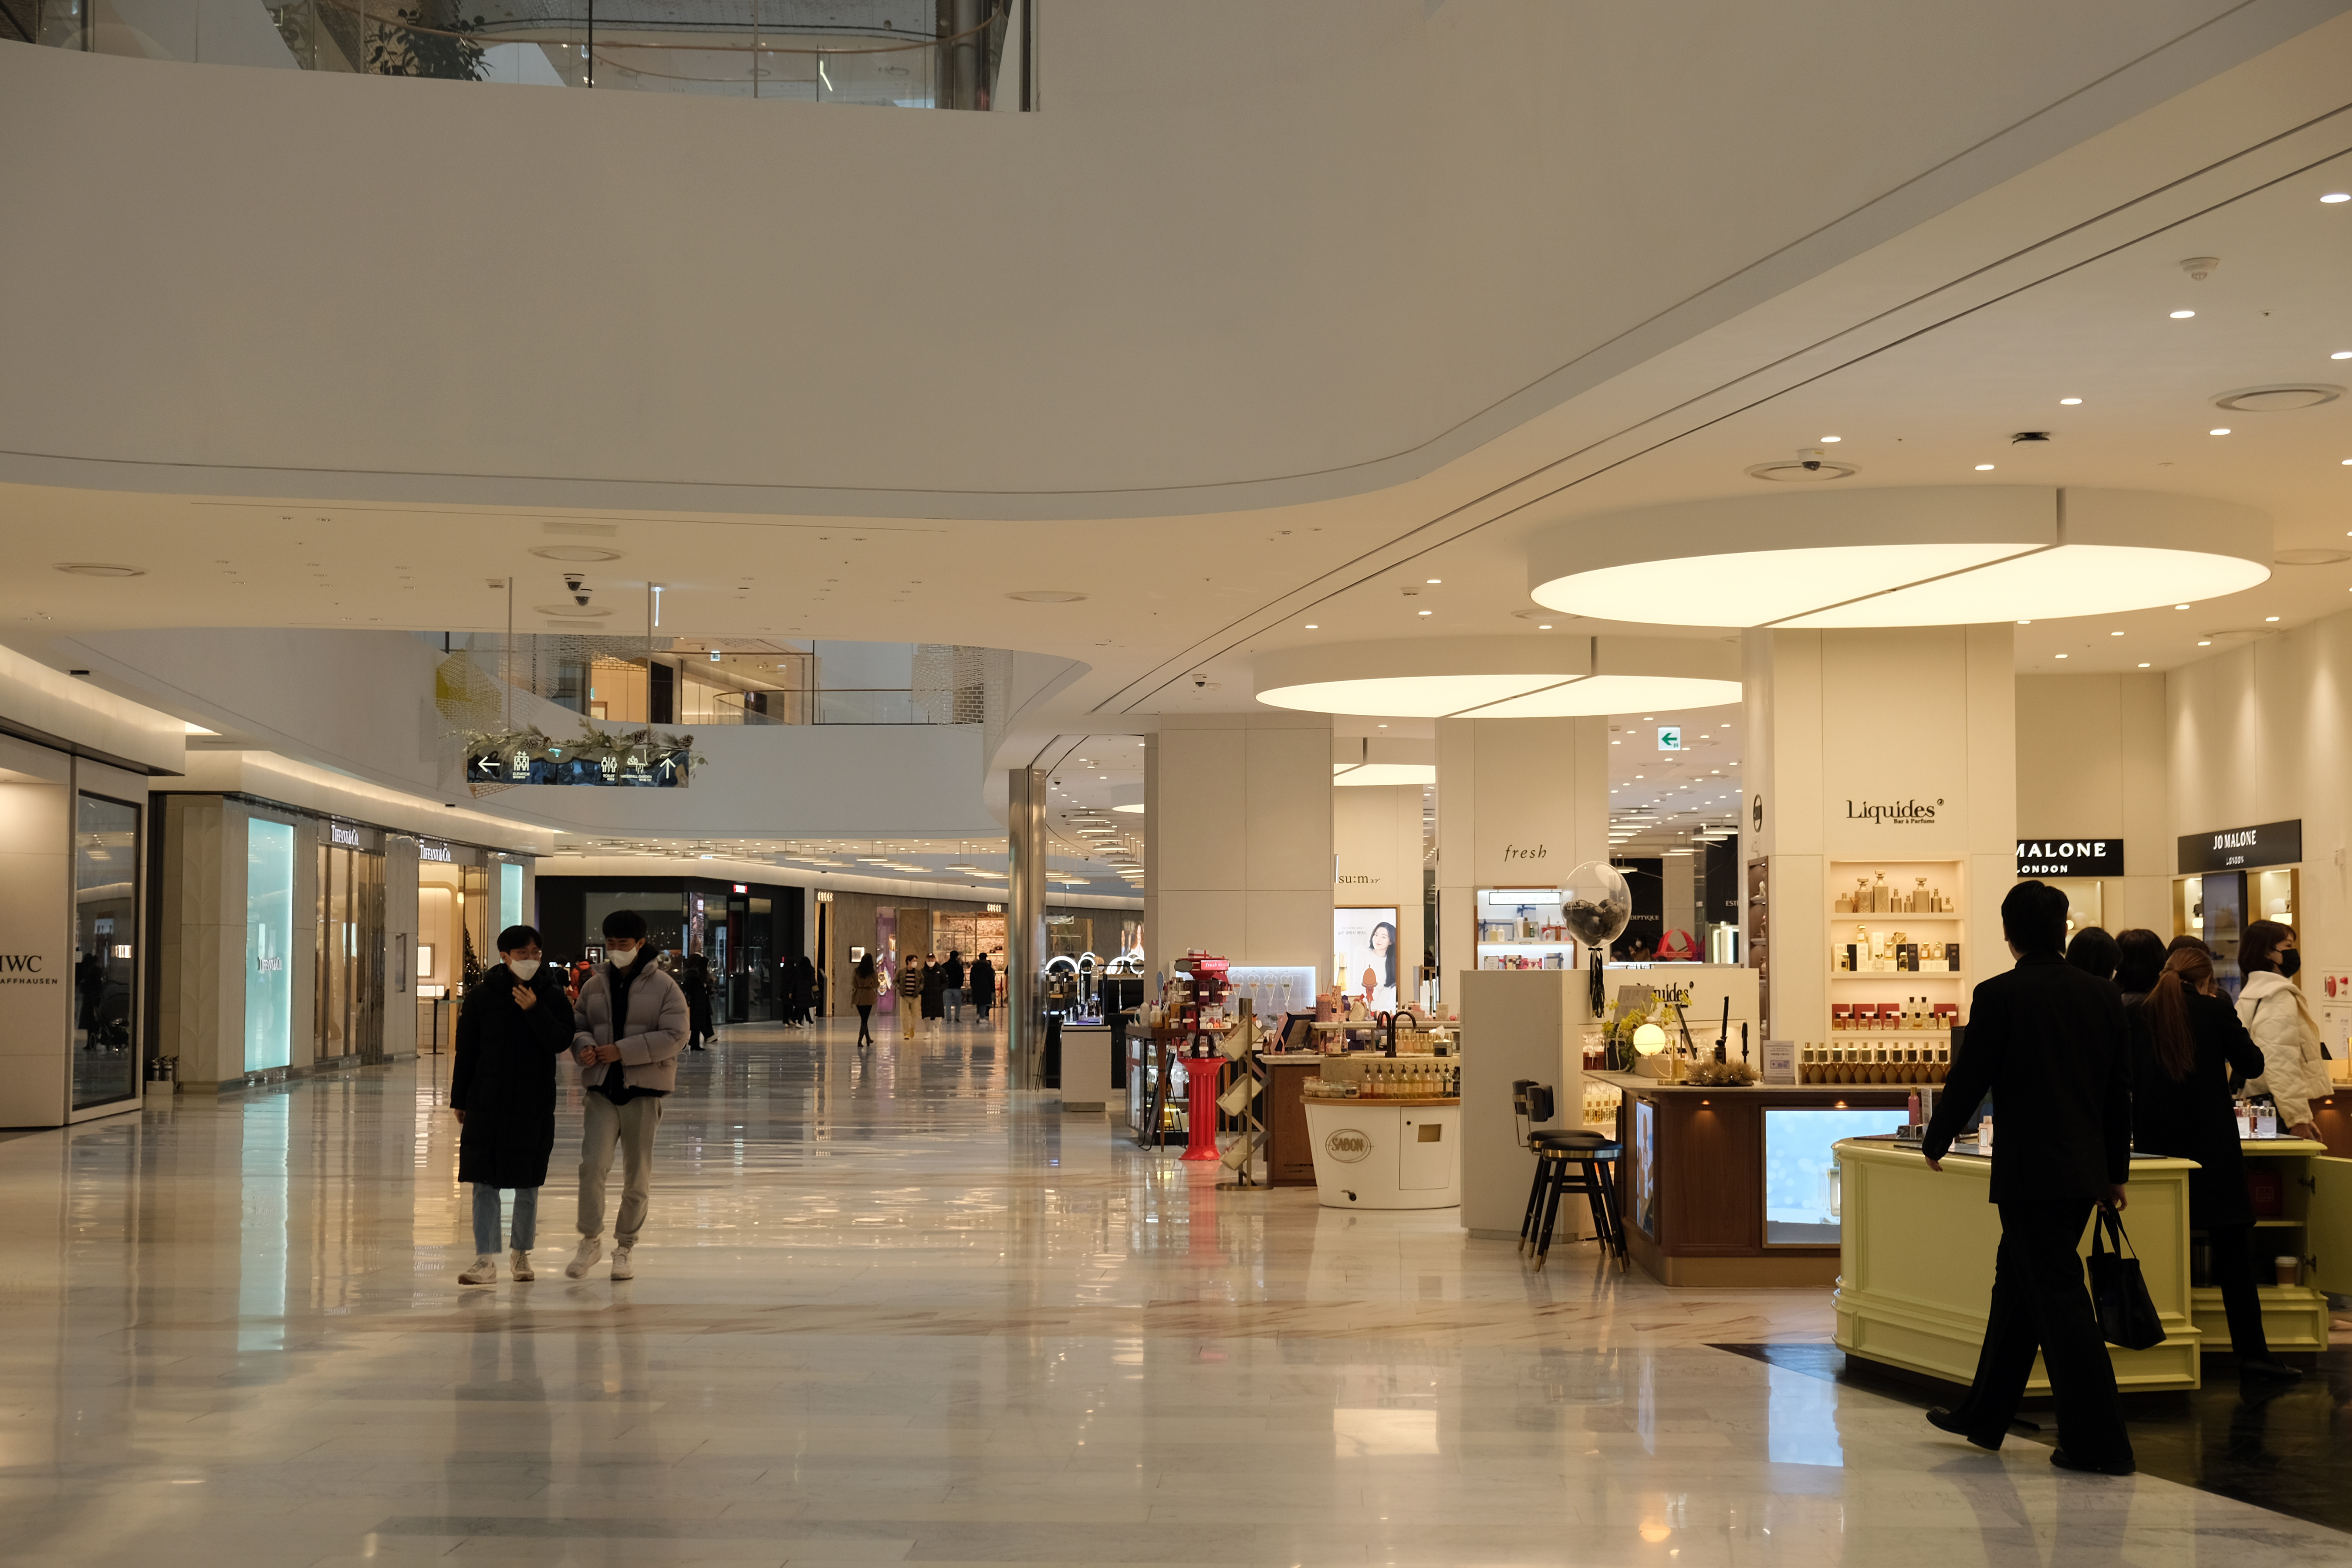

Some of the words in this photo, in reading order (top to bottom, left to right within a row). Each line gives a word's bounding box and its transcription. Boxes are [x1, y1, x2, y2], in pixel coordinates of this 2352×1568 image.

[1846, 799, 1935, 824] Liquides
[2213, 835, 2223, 850] JO
[2224, 830, 2257, 848] MALONE
[1504, 845, 1546, 862] fresh
[0, 955, 41, 972] IWC
[1331, 1138, 1363, 1152] SABON
